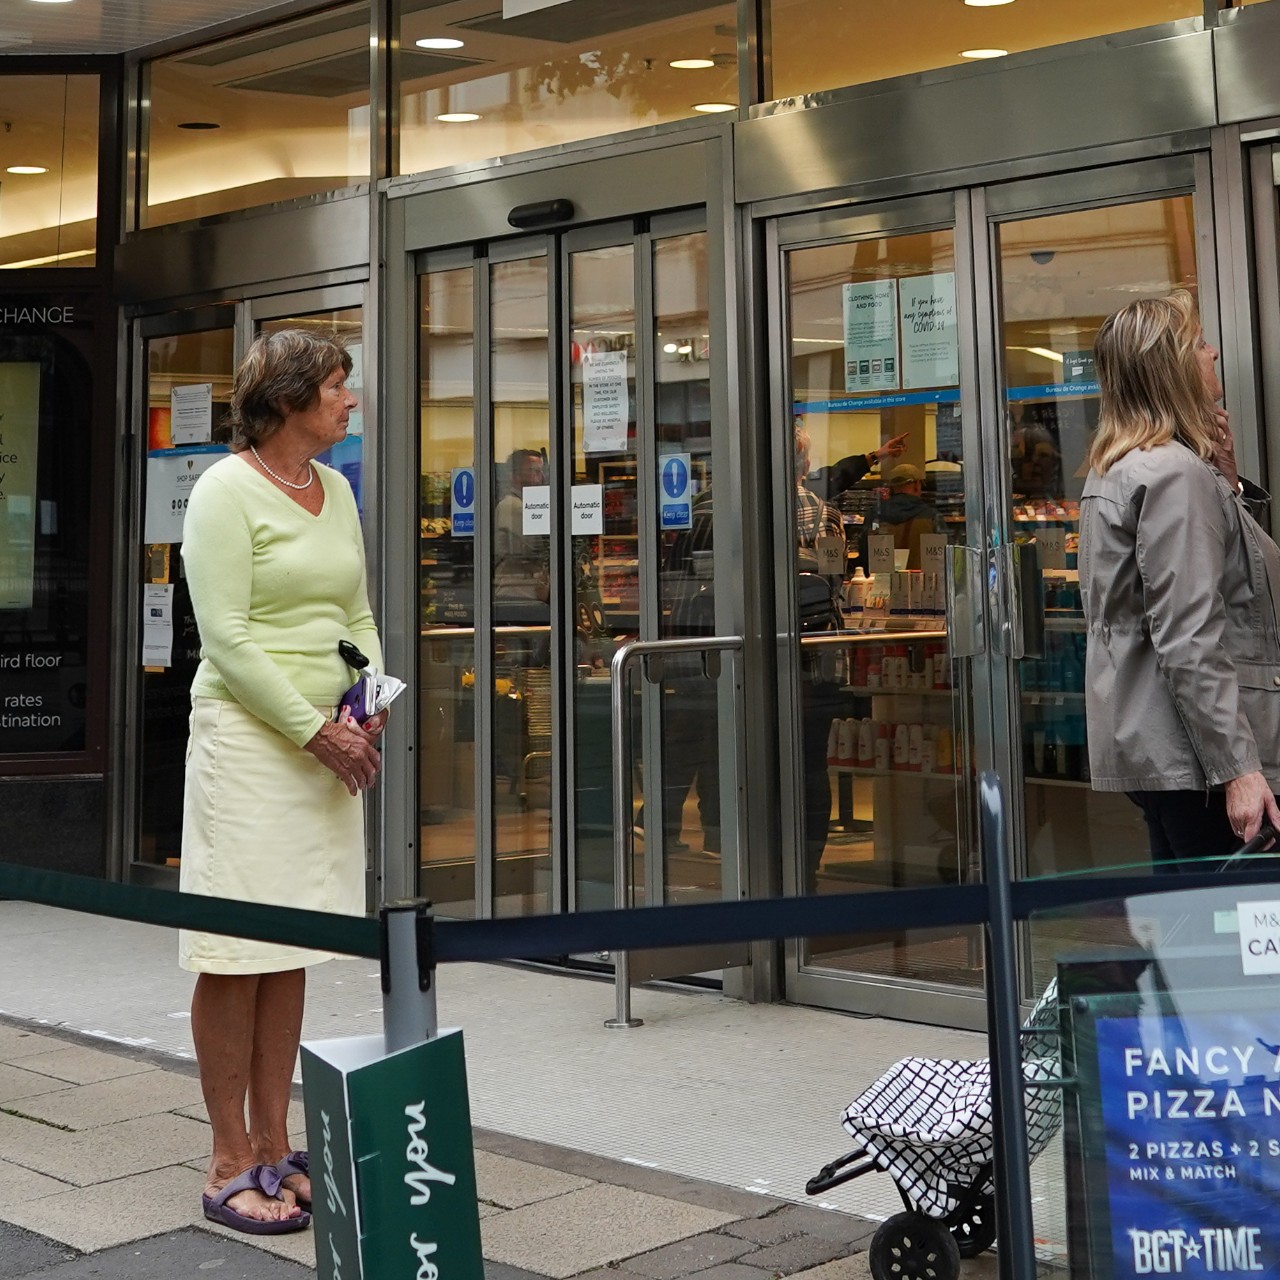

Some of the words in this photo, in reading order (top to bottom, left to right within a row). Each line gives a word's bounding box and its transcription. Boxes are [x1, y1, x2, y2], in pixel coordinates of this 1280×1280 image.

[848, 294, 874, 302] CLOTHING,
[911, 298, 917, 307] If
[918, 299, 928, 309] you
[930, 295, 944, 306] have
[904, 312, 916, 322] any
[918, 309, 944, 321] symptoms
[946, 306, 952, 316] of
[848, 399, 863, 407] Change
[177, 474, 188, 483] SHOP
[573, 501, 600, 509] Automatic
[531, 512, 543, 520] door
[581, 511, 593, 520] door
[663, 511, 676, 519] Keep
[873, 546, 890, 557] M&S
[925, 546, 943, 556] M&S
[1041, 541, 1060, 552] M&S
[823, 548, 839, 559] M&S
[25, 654, 62, 668] floor
[5, 694, 42, 707] rates
[1125, 1045, 1255, 1077] FANCY
[1127, 1090, 1246, 1120] PIZZA
[404, 1100, 456, 1206] you
[1129, 1143, 1139, 1159] 2
[1146, 1141, 1224, 1159] PIZZAS
[1231, 1144, 1241, 1155] +
[1249, 1141, 1260, 1157] 2
[321, 1109, 347, 1217] you
[1130, 1168, 1160, 1181] MIX
[1164, 1168, 1175, 1180] &
[1181, 1166, 1236, 1180] MATCH
[410, 1232, 438, 1280] or
